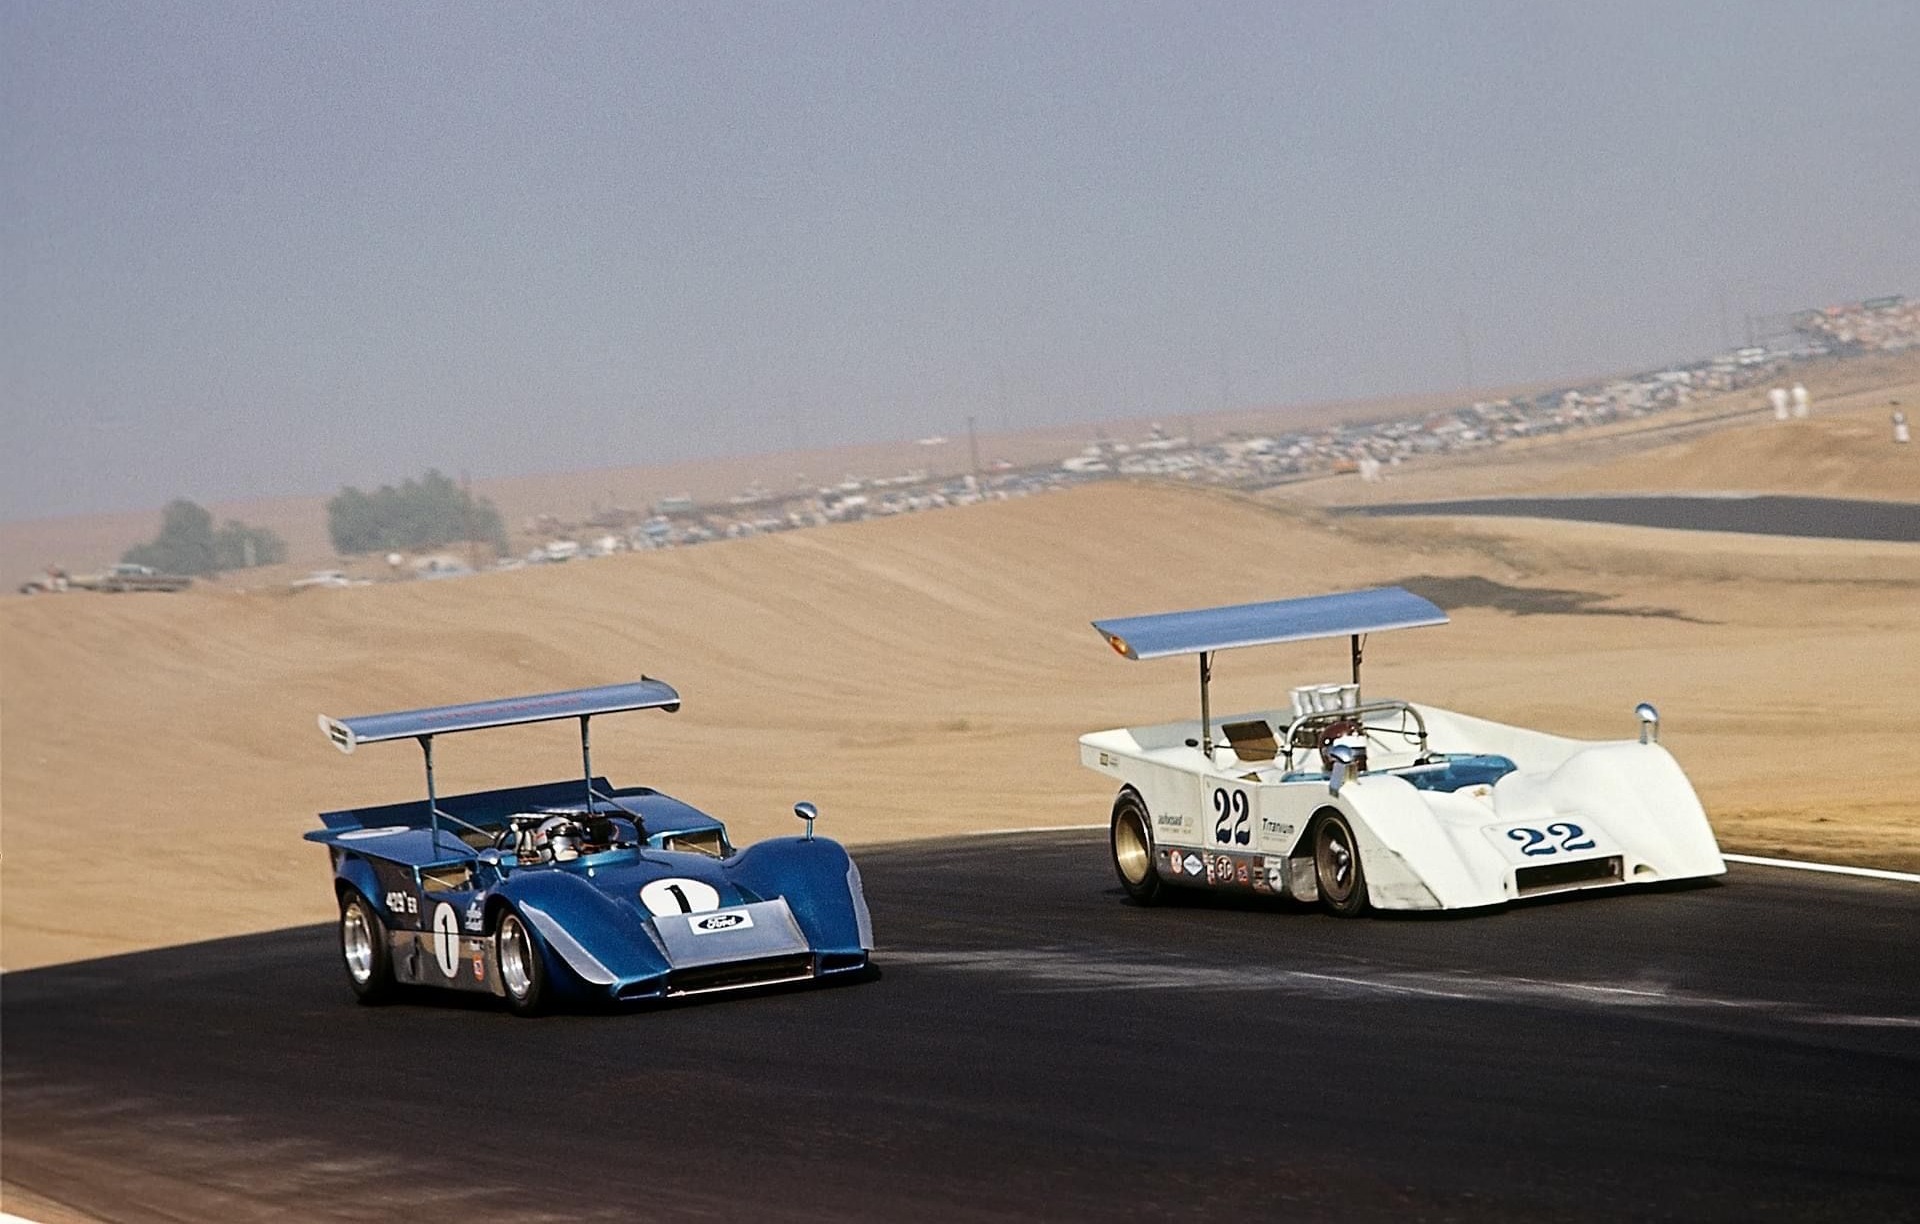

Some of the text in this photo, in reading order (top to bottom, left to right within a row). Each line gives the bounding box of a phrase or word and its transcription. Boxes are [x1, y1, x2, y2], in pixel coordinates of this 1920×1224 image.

[1213, 787, 1251, 846] 22
[1507, 823, 1596, 856] 22
[663, 884, 693, 914] 1
[706, 914, 738, 930] Ford
[441, 914, 452, 970] 1
